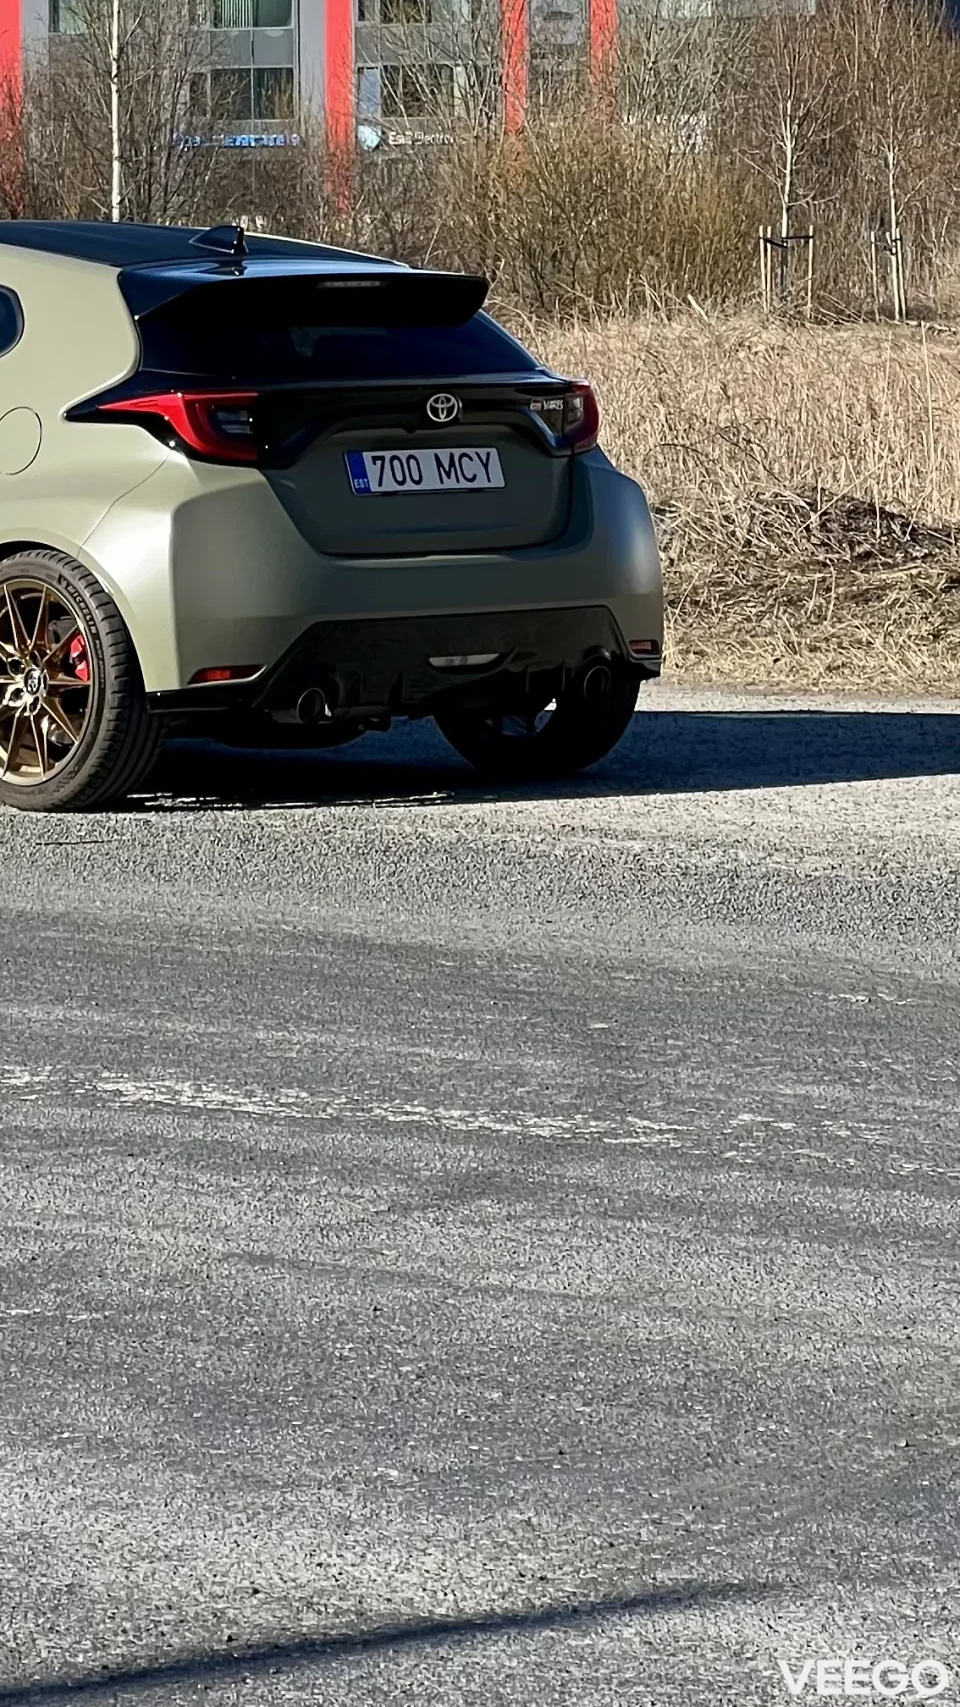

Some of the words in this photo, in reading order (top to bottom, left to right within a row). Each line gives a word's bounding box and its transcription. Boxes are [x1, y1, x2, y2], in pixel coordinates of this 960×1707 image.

[353, 478, 369, 489] EST
[371, 454, 423, 487] 700
[434, 451, 491, 484] MCY
[66, 584, 98, 635] MICHELIN
